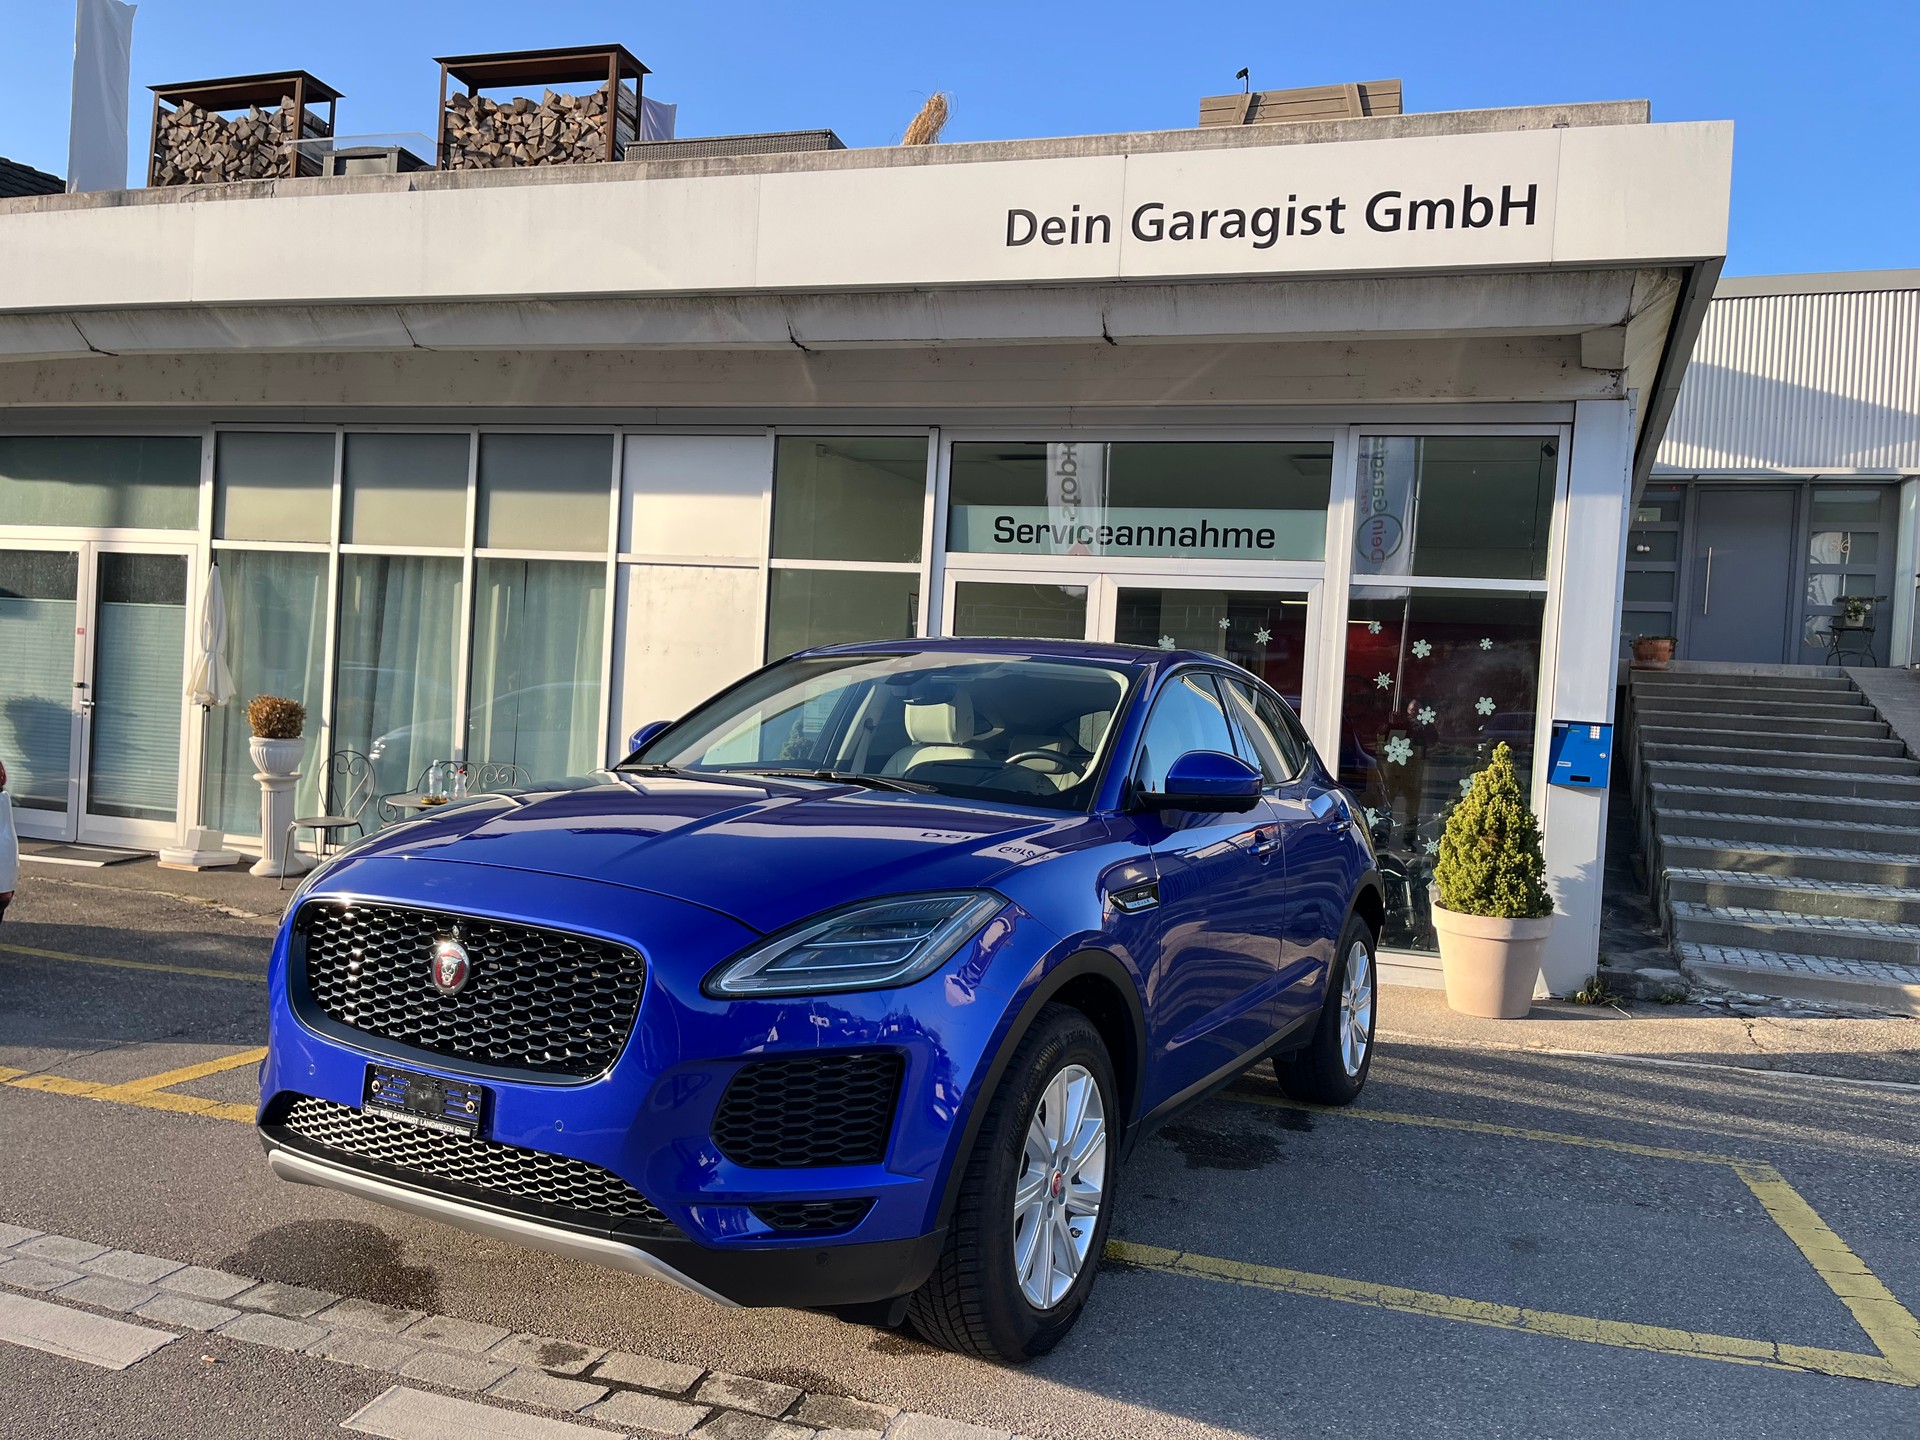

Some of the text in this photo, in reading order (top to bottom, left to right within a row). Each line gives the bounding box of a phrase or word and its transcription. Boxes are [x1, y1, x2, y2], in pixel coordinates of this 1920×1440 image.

[1006, 183, 1538, 249] Dein Garagist GmbH
[993, 515, 1276, 549] Serviceannahme
[380, 1109, 393, 1119] DEIN
[393, 1112, 420, 1125] GARAGIST
[420, 1119, 455, 1133] LANGWIESEN
